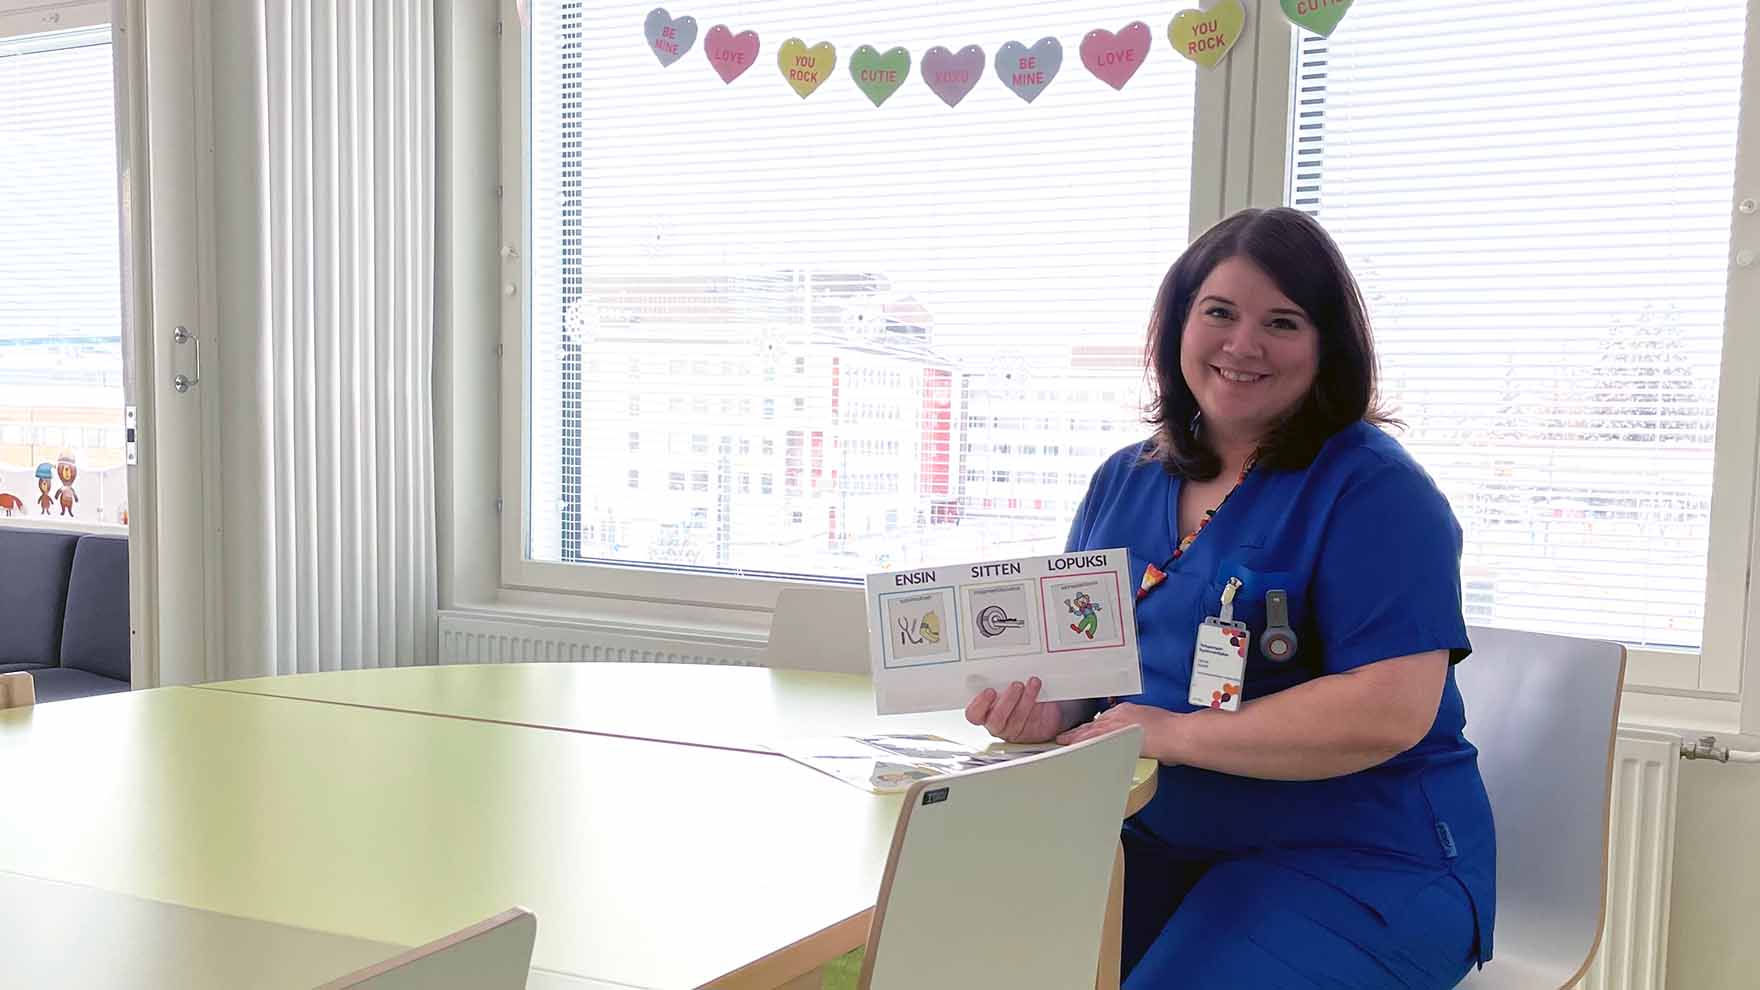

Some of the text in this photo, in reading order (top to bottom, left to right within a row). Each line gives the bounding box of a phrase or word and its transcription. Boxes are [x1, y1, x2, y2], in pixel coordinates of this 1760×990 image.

[661, 26, 678, 40] BE
[1192, 19, 1218, 36] YOU
[655, 38, 680, 55] MINE
[1188, 34, 1226, 55] ROCK
[714, 48, 745, 64] LOVE
[795, 56, 816, 68] YOU
[1018, 56, 1037, 70] BE
[1097, 48, 1135, 66] LOVE
[789, 68, 818, 83] ROCK
[860, 69, 897, 82] CUTIE
[1012, 71, 1045, 86] MINE
[895, 554, 1108, 586] ENSIN SITTEN LOPUKSI
